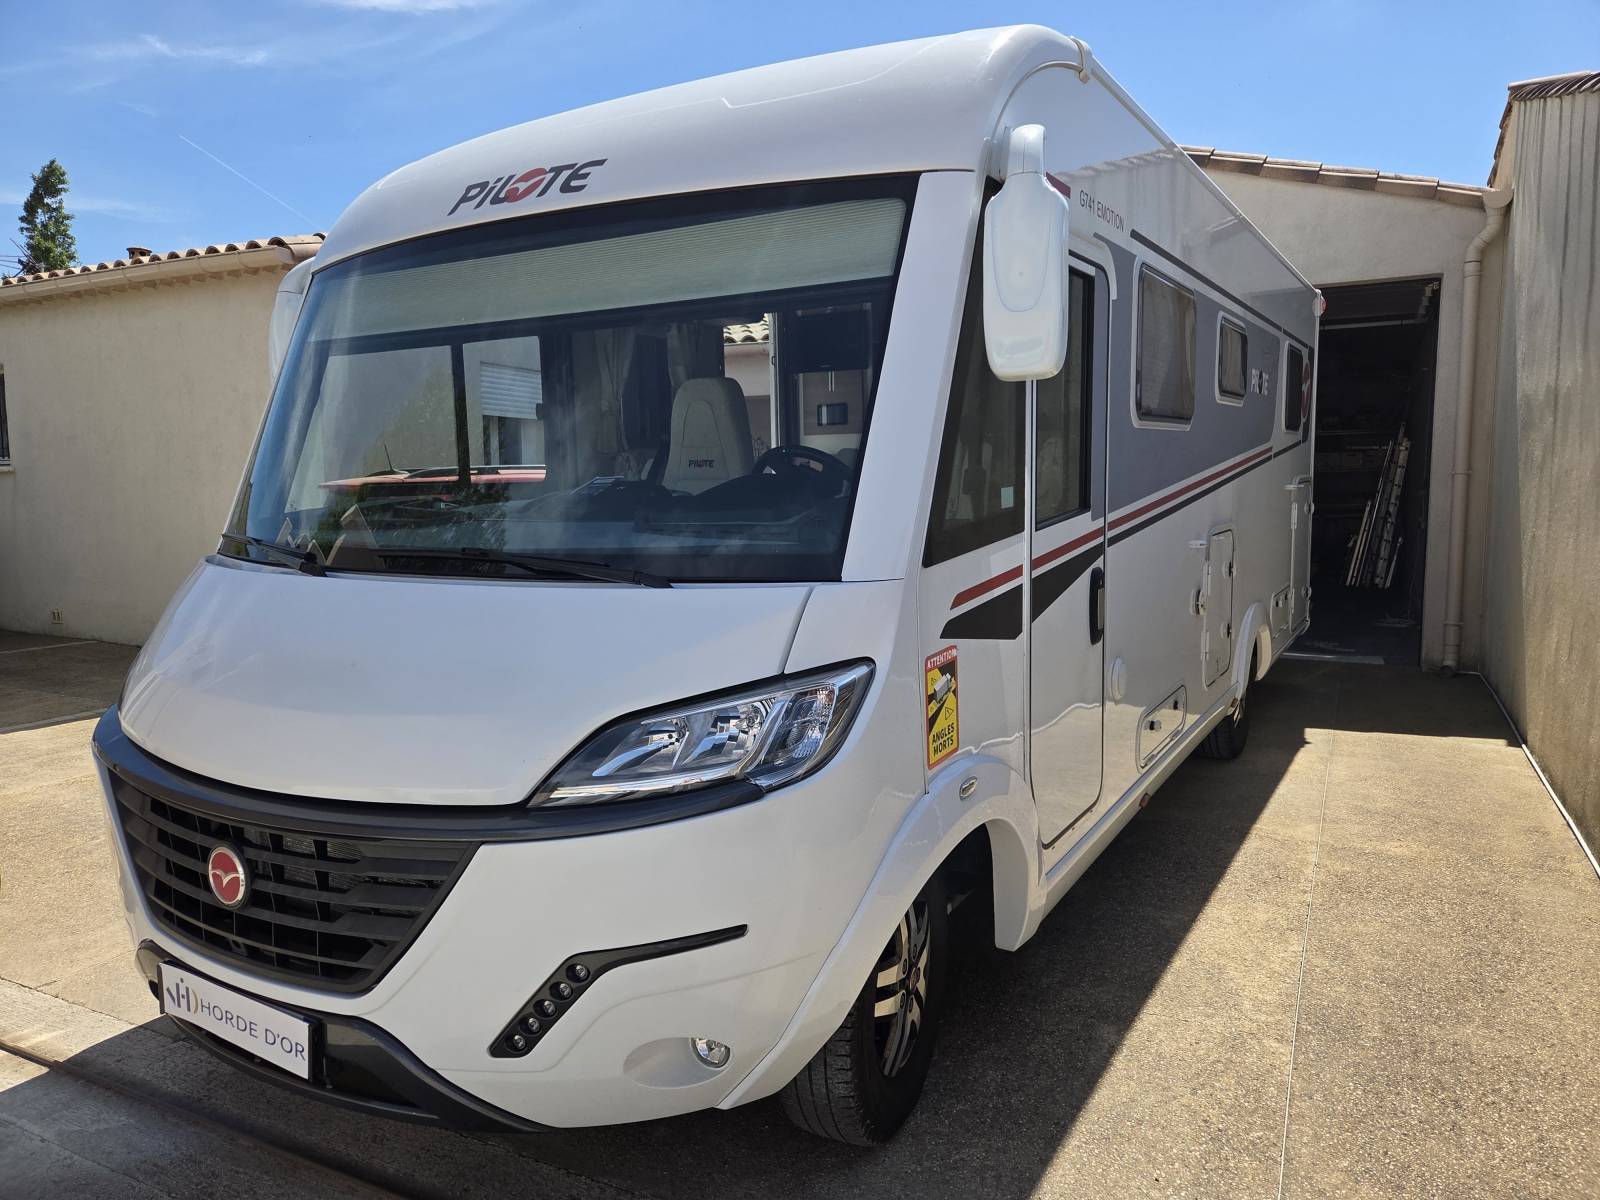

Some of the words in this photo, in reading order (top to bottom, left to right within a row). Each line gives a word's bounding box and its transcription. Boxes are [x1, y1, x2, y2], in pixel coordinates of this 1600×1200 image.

[1080, 190, 1095, 215] G741
[1097, 201, 1124, 232] EMOTION
[932, 722, 954, 745] ANGLES
[933, 735, 953, 757] MORTS
[200, 998, 258, 1039] HORDE
[264, 1028, 305, 1061] D'OR
